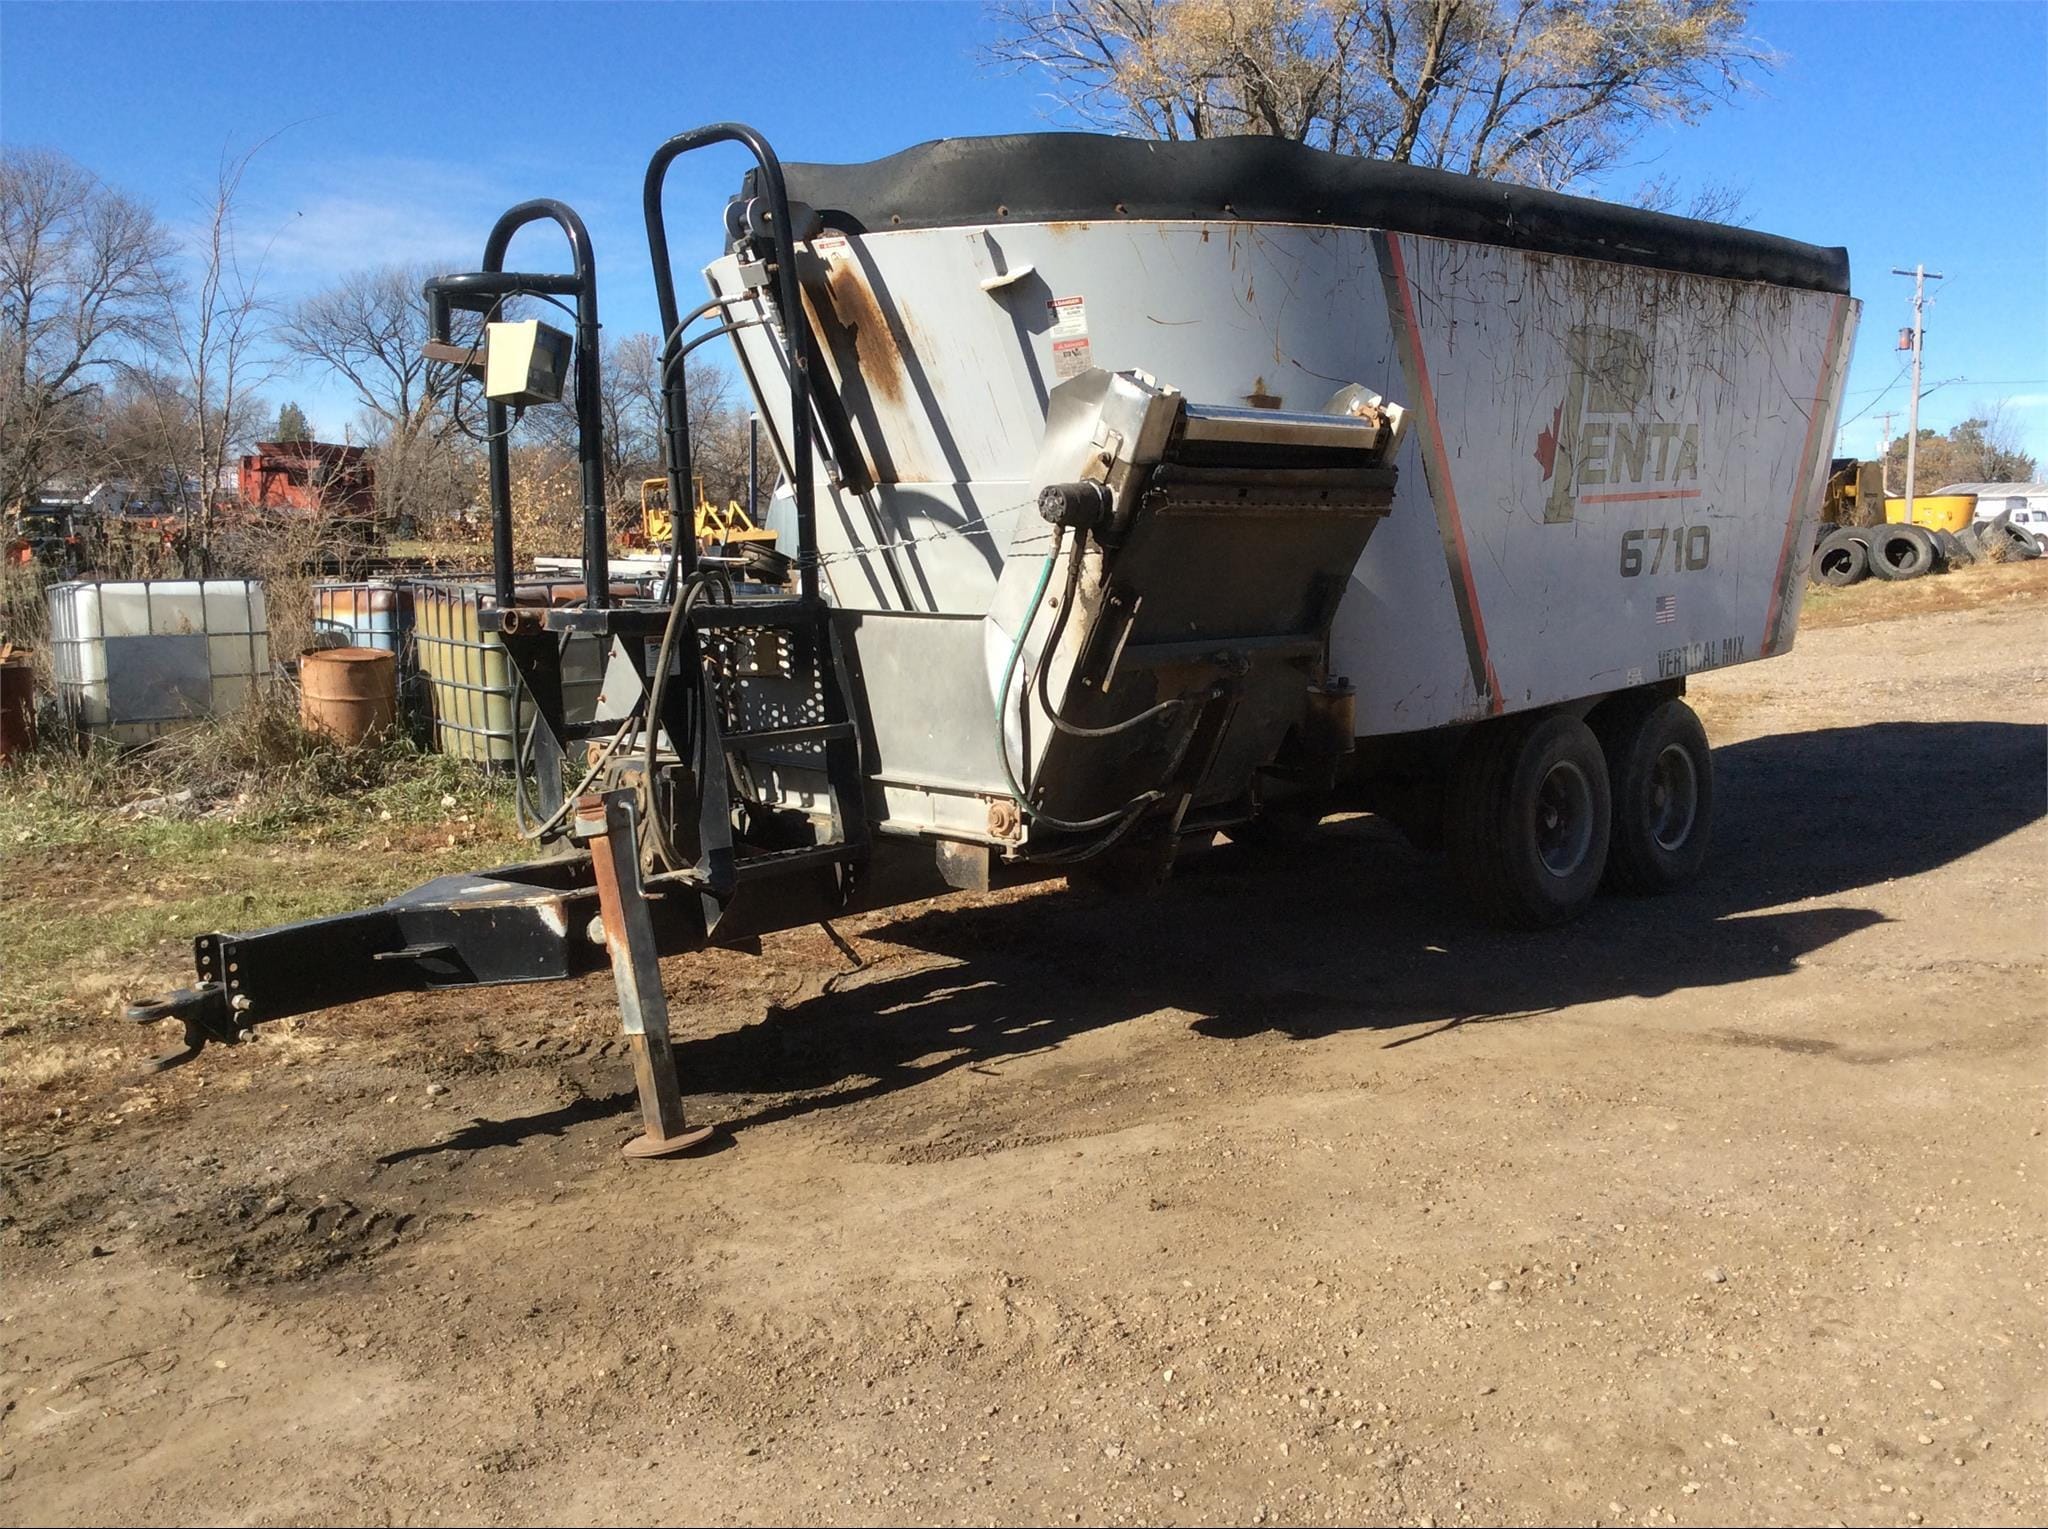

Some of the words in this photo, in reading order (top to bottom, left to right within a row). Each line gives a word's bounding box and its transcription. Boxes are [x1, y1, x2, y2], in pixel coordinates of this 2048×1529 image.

[1544, 326, 1698, 523] PENTA
[1620, 525, 1710, 577] 6710
[1658, 640, 1719, 678] VERTICAL
[1722, 635, 1744, 664] MIX
